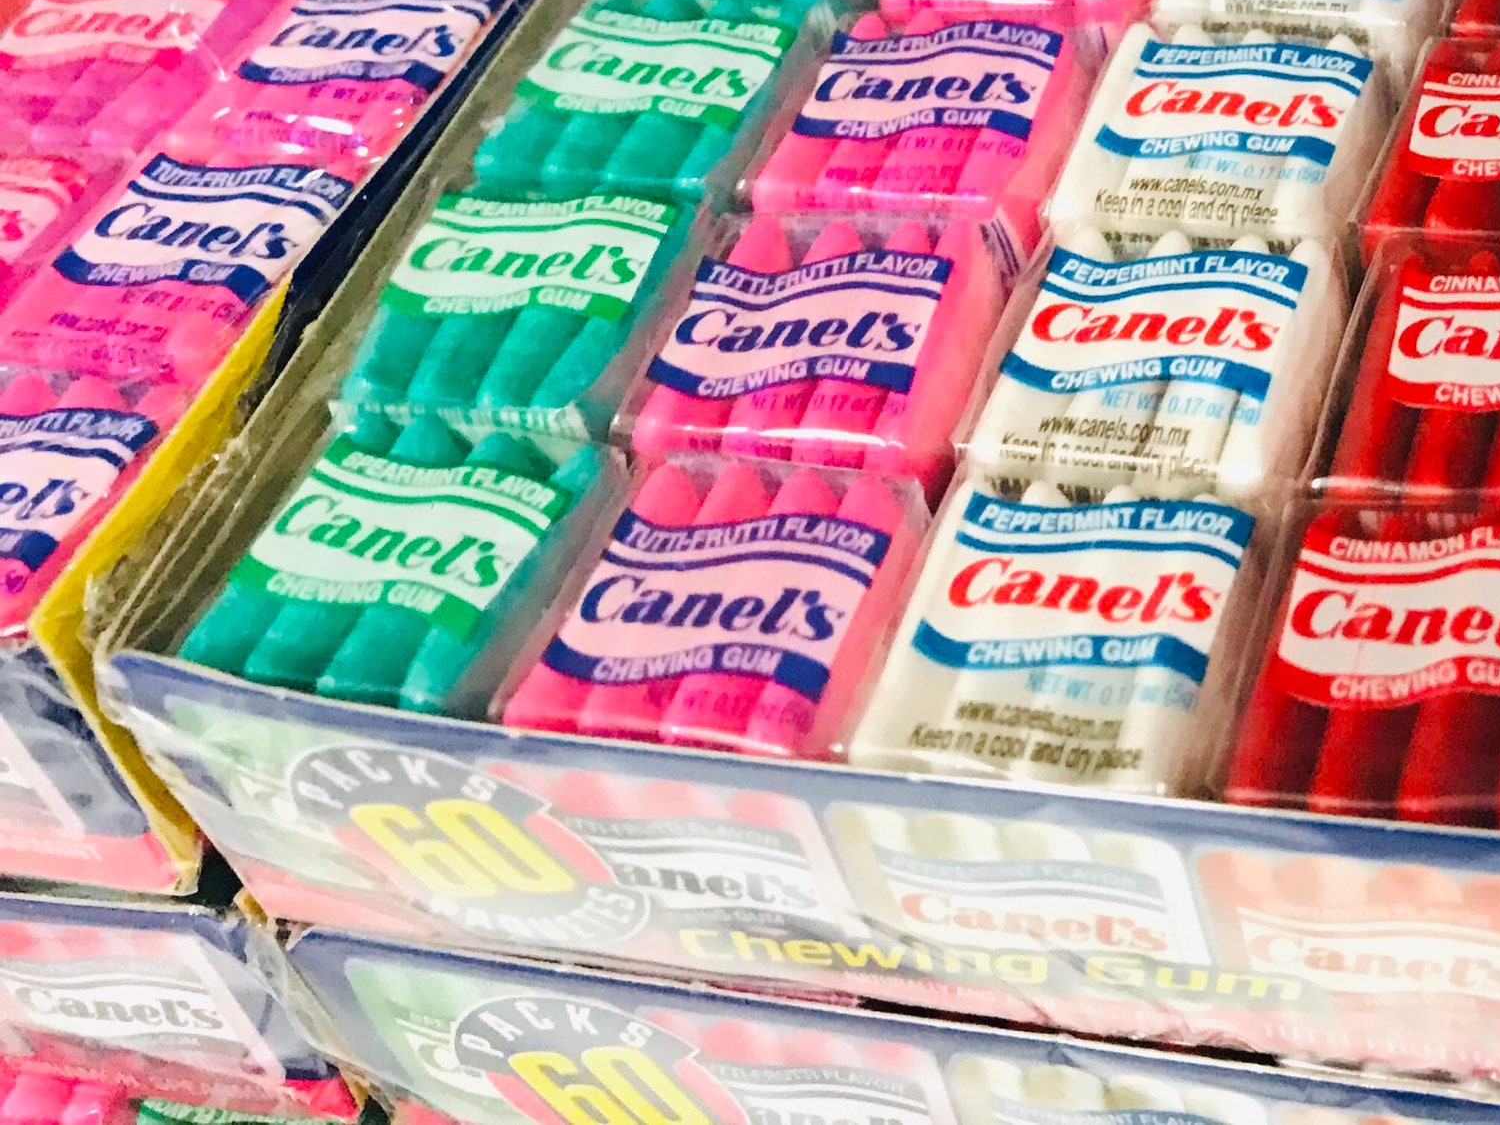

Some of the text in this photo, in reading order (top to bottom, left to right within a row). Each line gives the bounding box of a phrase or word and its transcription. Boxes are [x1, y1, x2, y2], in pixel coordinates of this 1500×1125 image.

[270, 23, 463, 58] Canel's
[845, 22, 1052, 57] TUTTI-FRUTTI FLAVOR
[1153, 44, 1356, 73] PEPPERMINT FLAVOR
[547, 36, 753, 99] Canel's
[814, 66, 1038, 107] Canel's
[555, 93, 707, 118] CHEWING GUM
[835, 108, 992, 140] CHEWING GUM
[1125, 79, 1345, 131] Canel's
[1139, 132, 1296, 154] CHEWING GUM
[456, 194, 669, 221] SPEARMINT FLAVOR
[1094, 188, 1127, 221] Keep
[1130, 194, 1144, 214] in
[1158, 196, 1187, 219] cool
[1190, 197, 1215, 220] and
[1217, 199, 1238, 229] dry
[1241, 201, 1278, 225] place
[1129, 175, 1264, 201] www.canels.com.mx
[94, 202, 299, 261] Canel's
[408, 230, 647, 286] Canel's
[708, 251, 939, 297] TUTTI-FRUTTI FLAVOR
[1062, 254, 1291, 287] PEPPERMINT FLAVOR
[424, 286, 592, 314] CHEWING GUM
[673, 308, 923, 353] Canel's
[1030, 301, 1281, 354] Canel's
[698, 356, 871, 397] CHEWING GUM
[1051, 355, 1226, 391] CHEWING GUM
[1039, 415, 1193, 447] www.canels.com.mx
[340, 451, 559, 511] SPEARMINT FLAVOR
[273, 490, 510, 587] Canel's
[628, 516, 876, 553] TUTTI-FRUTTI FLAVOR
[978, 503, 1235, 536] PEPPERMINT FLAVOR
[1329, 534, 1466, 563] CINNAMON
[266, 571, 446, 616] CHEWING GUM
[580, 575, 846, 642] Canel's
[948, 557, 1221, 625] Canel's
[593, 644, 781, 682] CHEWING GUM
[966, 636, 1156, 665] CHEWING GUM
[1330, 663, 1458, 702] CHEWING
[297, 748, 499, 809] PACKS
[351, 798, 576, 899] 60
[899, 891, 1168, 953] Canel's
[678, 927, 1302, 1001] Chewing Gum
[15, 987, 223, 1030] Canel's
[461, 1001, 656, 1058] PACKS
[508, 1046, 712, 1125] 60
